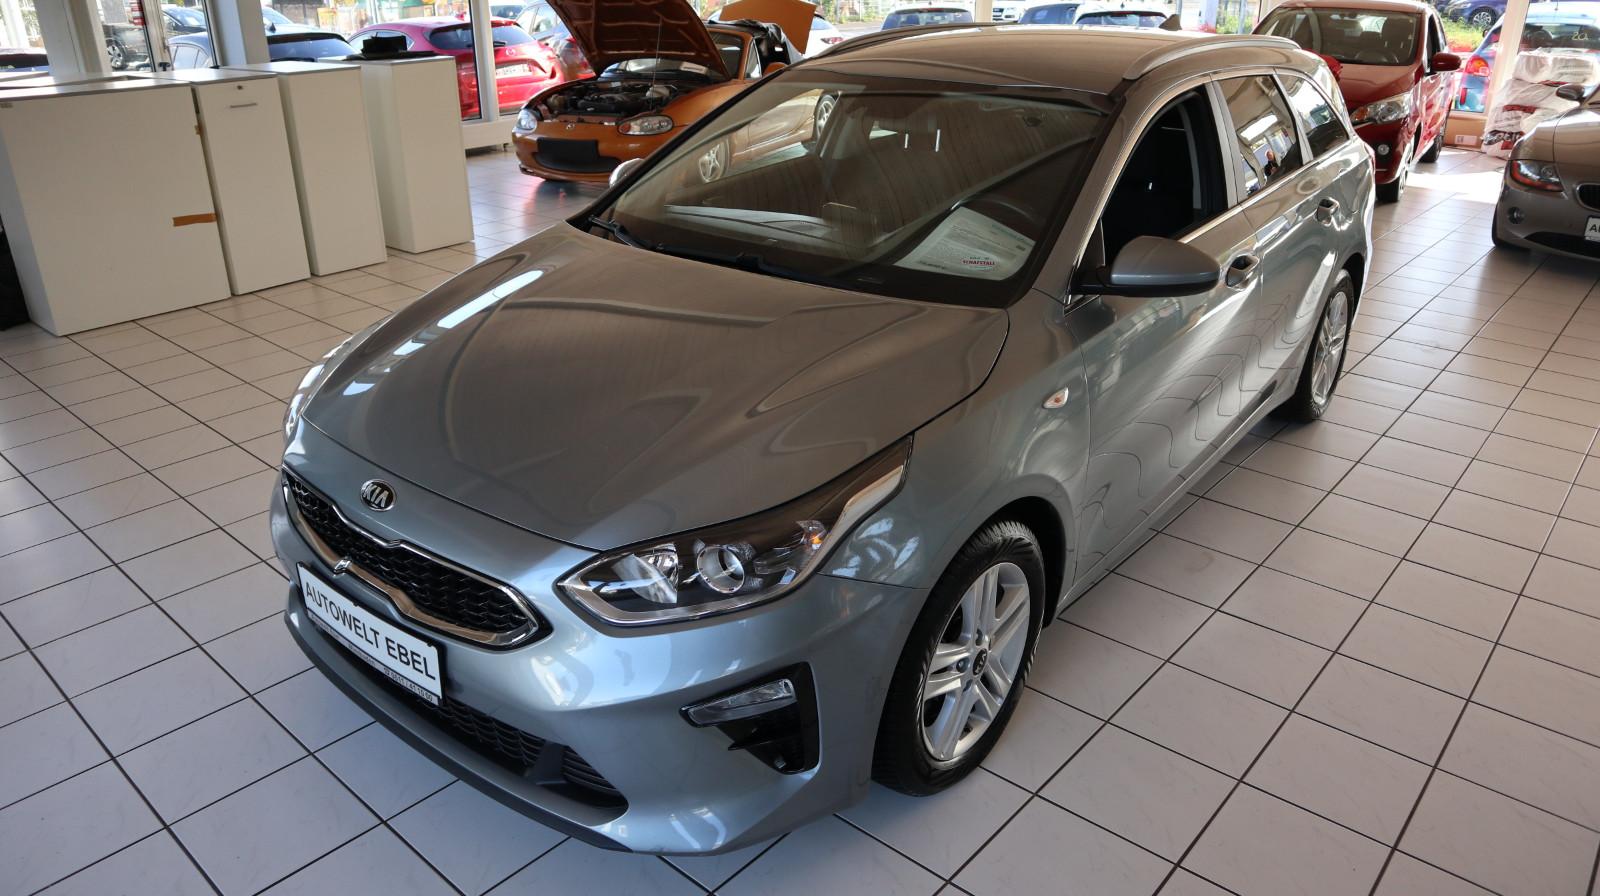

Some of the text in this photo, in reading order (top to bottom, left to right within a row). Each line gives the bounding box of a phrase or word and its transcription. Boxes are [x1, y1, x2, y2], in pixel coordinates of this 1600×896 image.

[362, 483, 390, 508] KIA
[305, 581, 380, 649] AUTOWELT
[384, 636, 437, 681] EBEL
